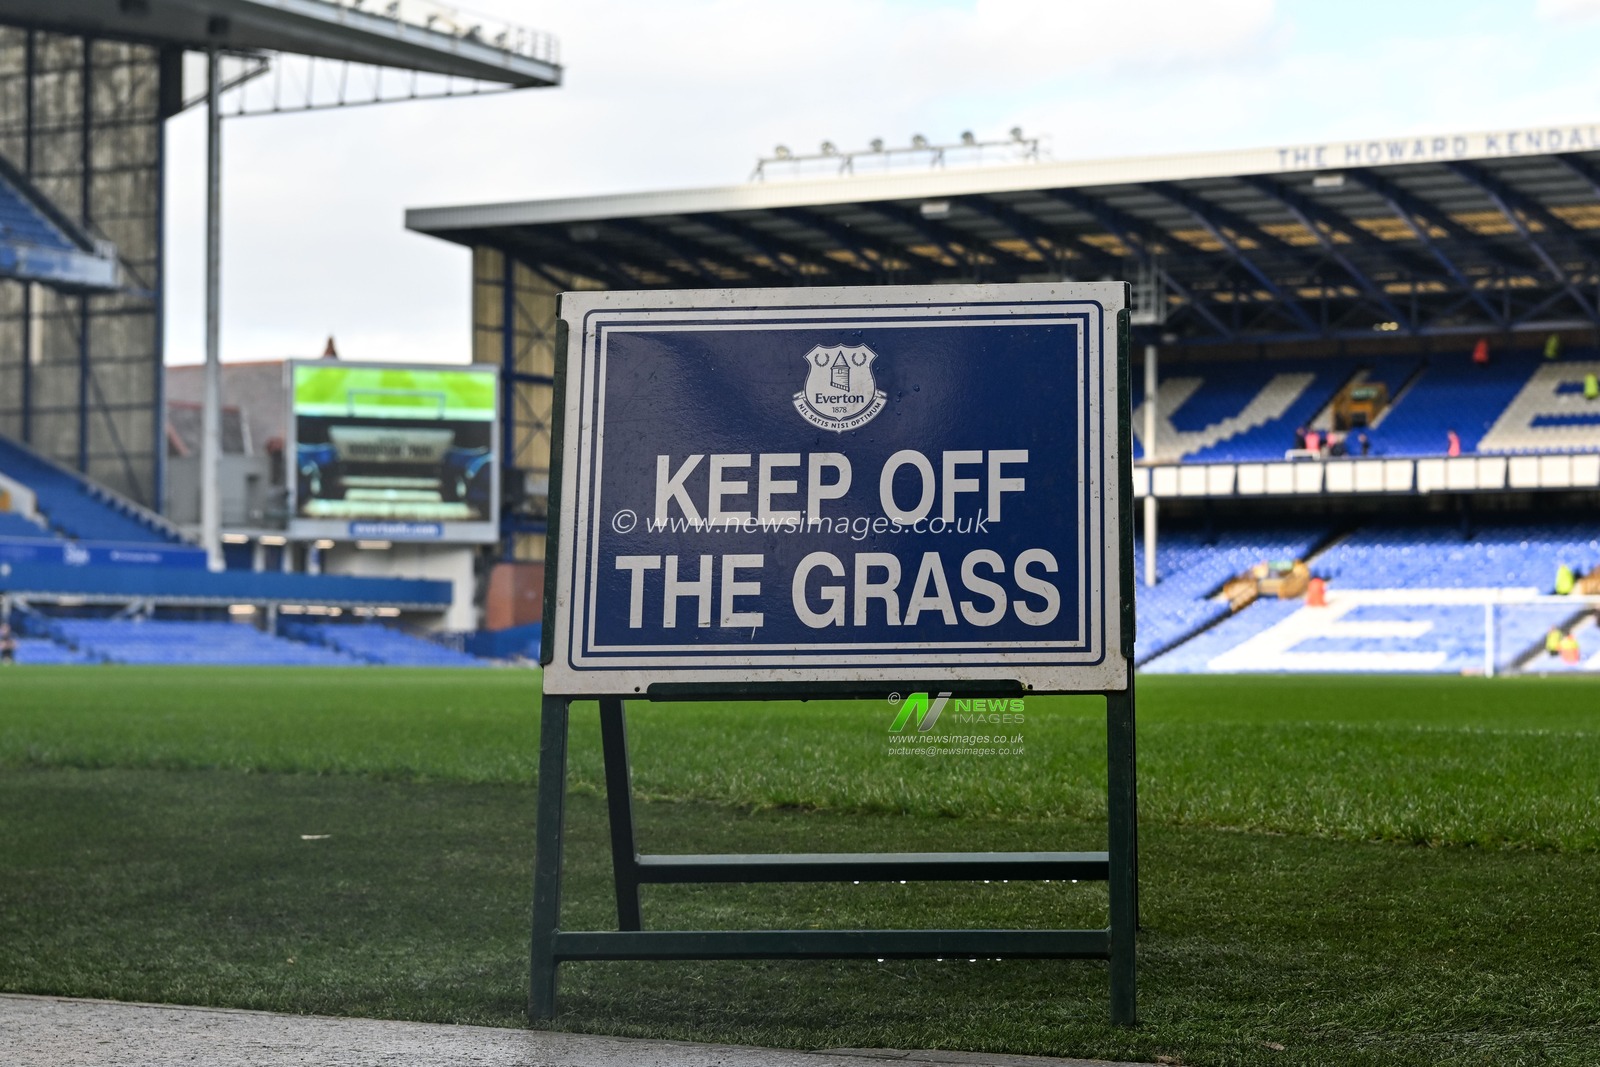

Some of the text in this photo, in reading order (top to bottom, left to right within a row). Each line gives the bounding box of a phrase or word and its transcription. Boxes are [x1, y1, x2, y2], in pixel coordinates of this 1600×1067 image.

[1278, 147, 1327, 168] THE
[1345, 136, 1467, 163] HOWARD
[815, 392, 864, 404] Everton
[832, 406, 847, 414] 1878
[798, 402, 882, 429] NIL SATIS NISI OPTIMUM
[654, 449, 1029, 528] KEEP OFF
[615, 548, 1061, 629] THE GRASS
